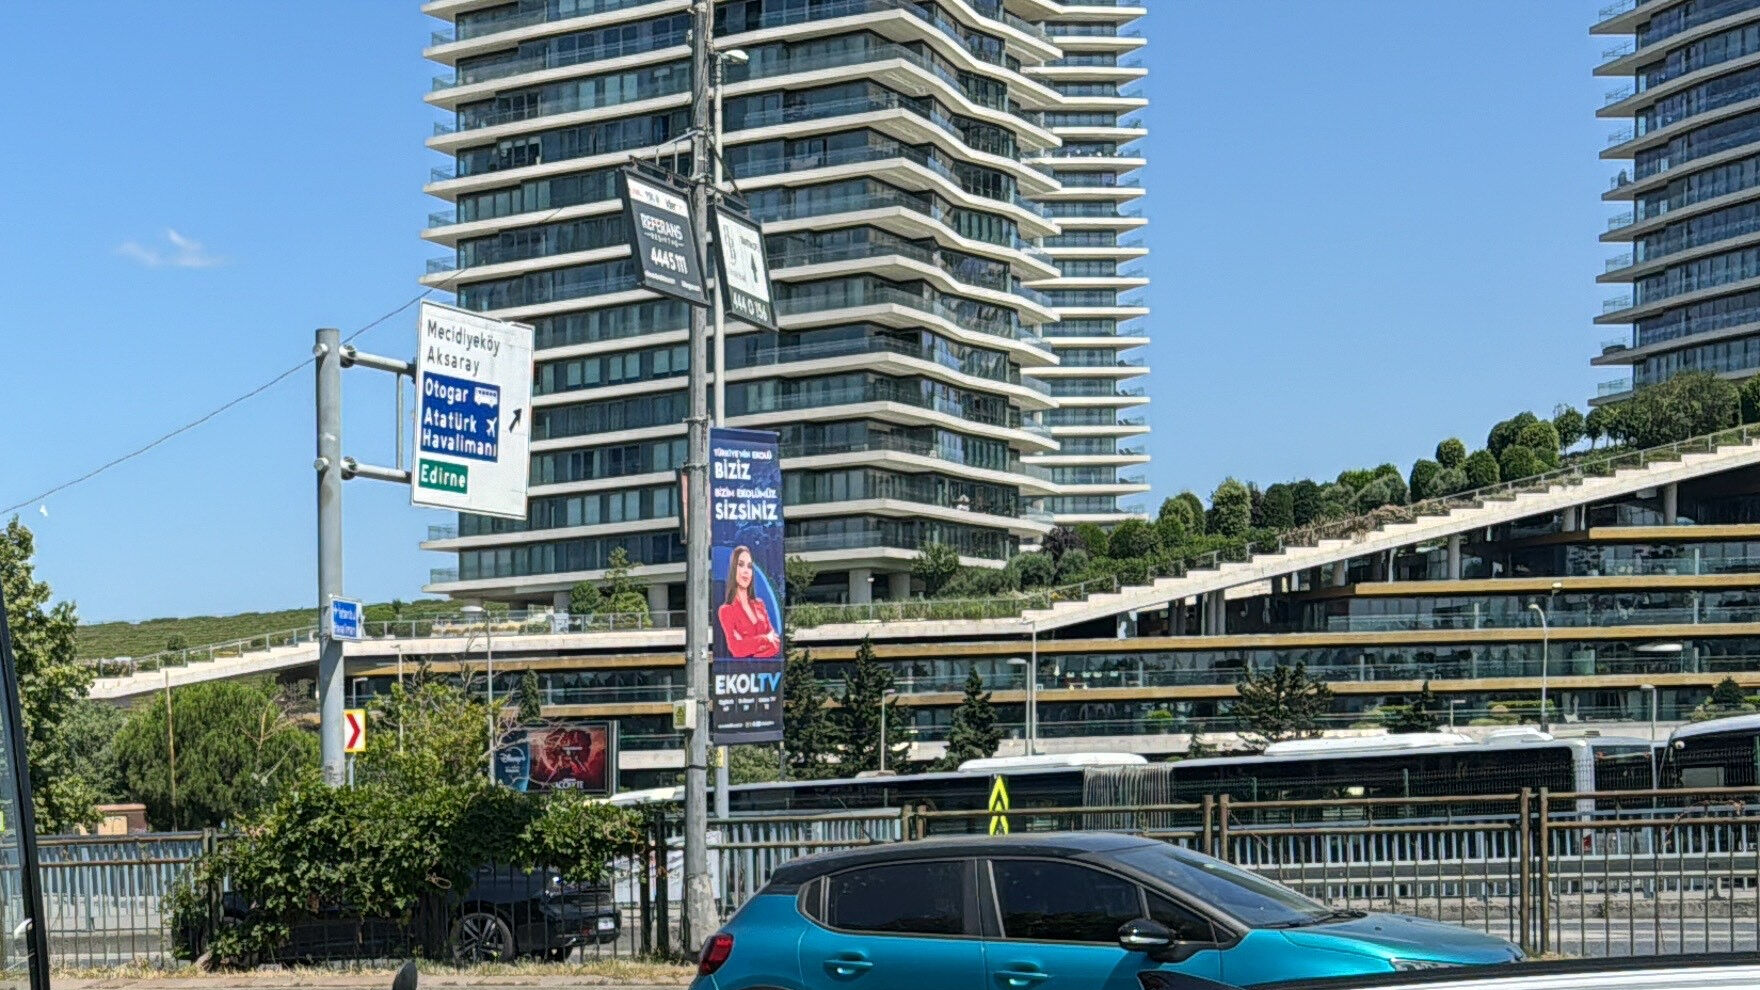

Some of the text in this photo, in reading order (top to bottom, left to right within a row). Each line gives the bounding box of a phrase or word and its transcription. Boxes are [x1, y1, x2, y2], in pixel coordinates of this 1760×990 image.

[427, 319, 501, 358] Mecidiyeköy
[427, 345, 480, 377] Aksaray
[424, 378, 468, 405] Otogar
[424, 407, 477, 433] Atatürk
[422, 427, 498, 458] Havalimanı
[420, 464, 466, 488] Edirne
[714, 459, 751, 480] BİZİZ
[715, 499, 778, 520] SİZSİNİZ
